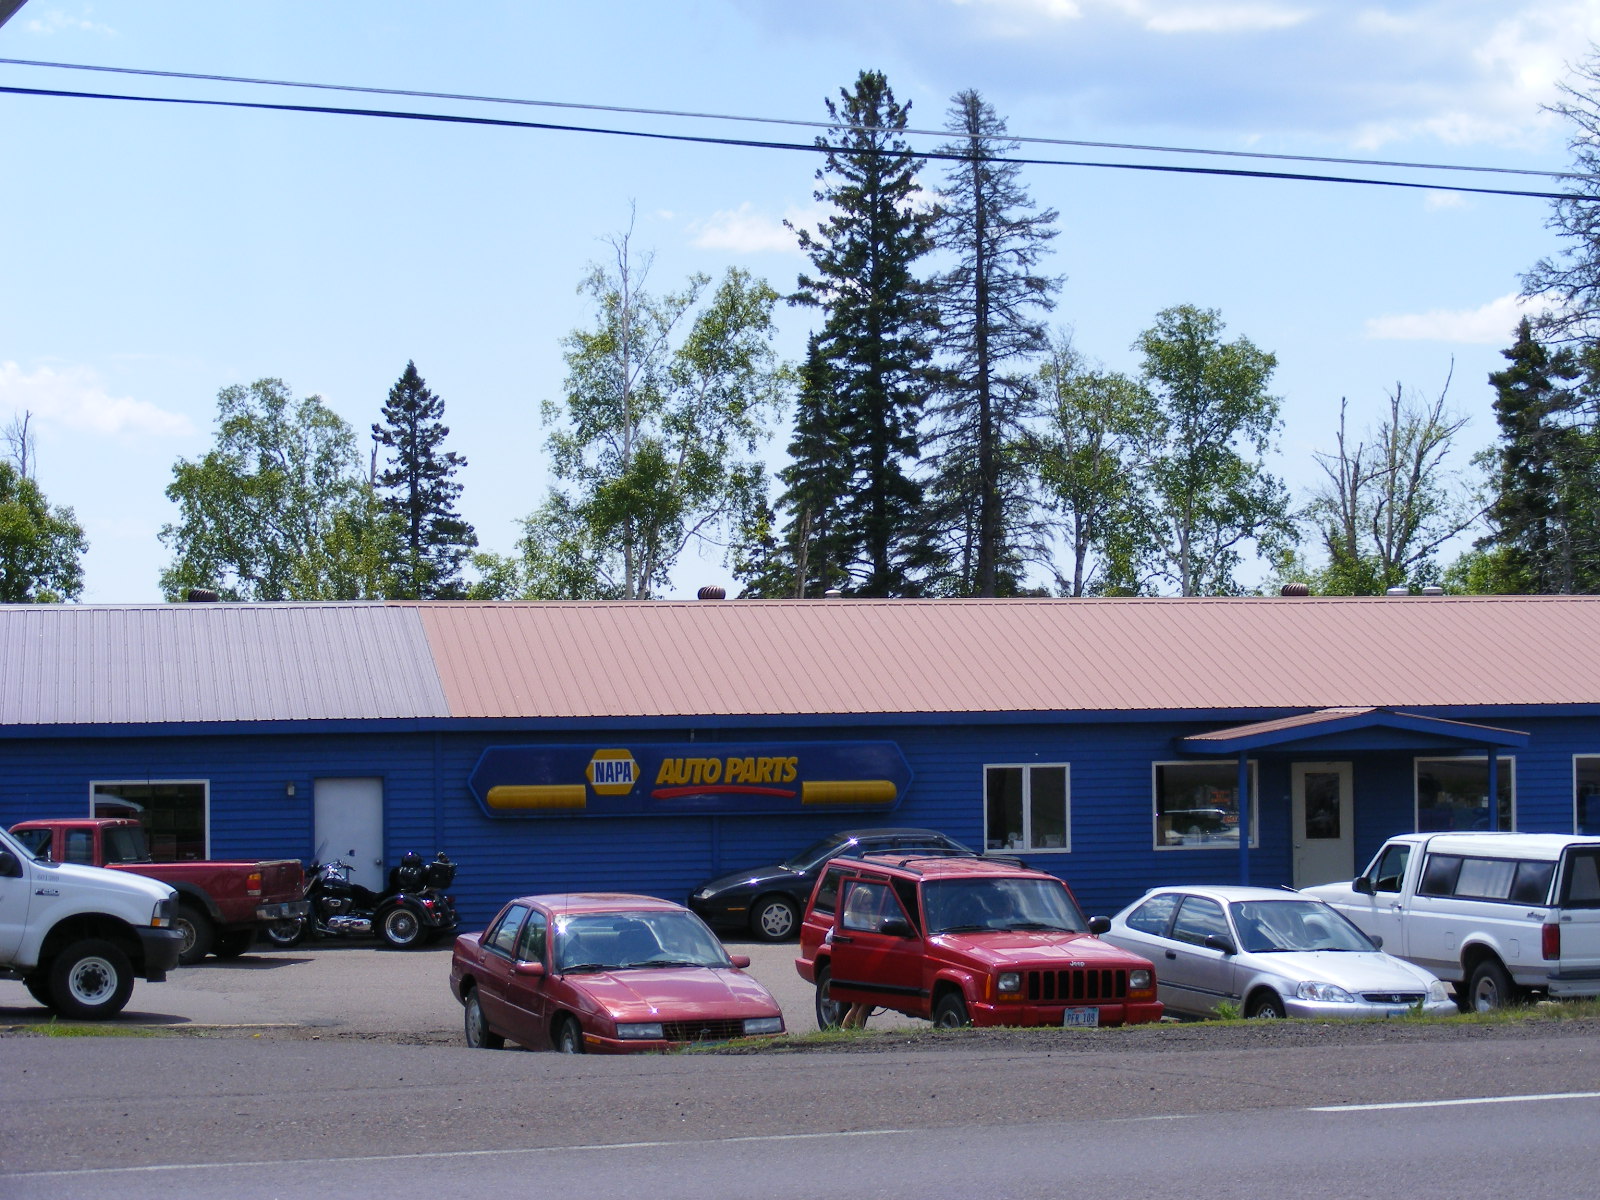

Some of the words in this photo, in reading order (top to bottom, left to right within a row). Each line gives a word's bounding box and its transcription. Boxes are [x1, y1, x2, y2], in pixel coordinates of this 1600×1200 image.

[595, 761, 632, 783] NAPA
[655, 758, 722, 784] AUTO
[724, 757, 798, 783] PARTS
